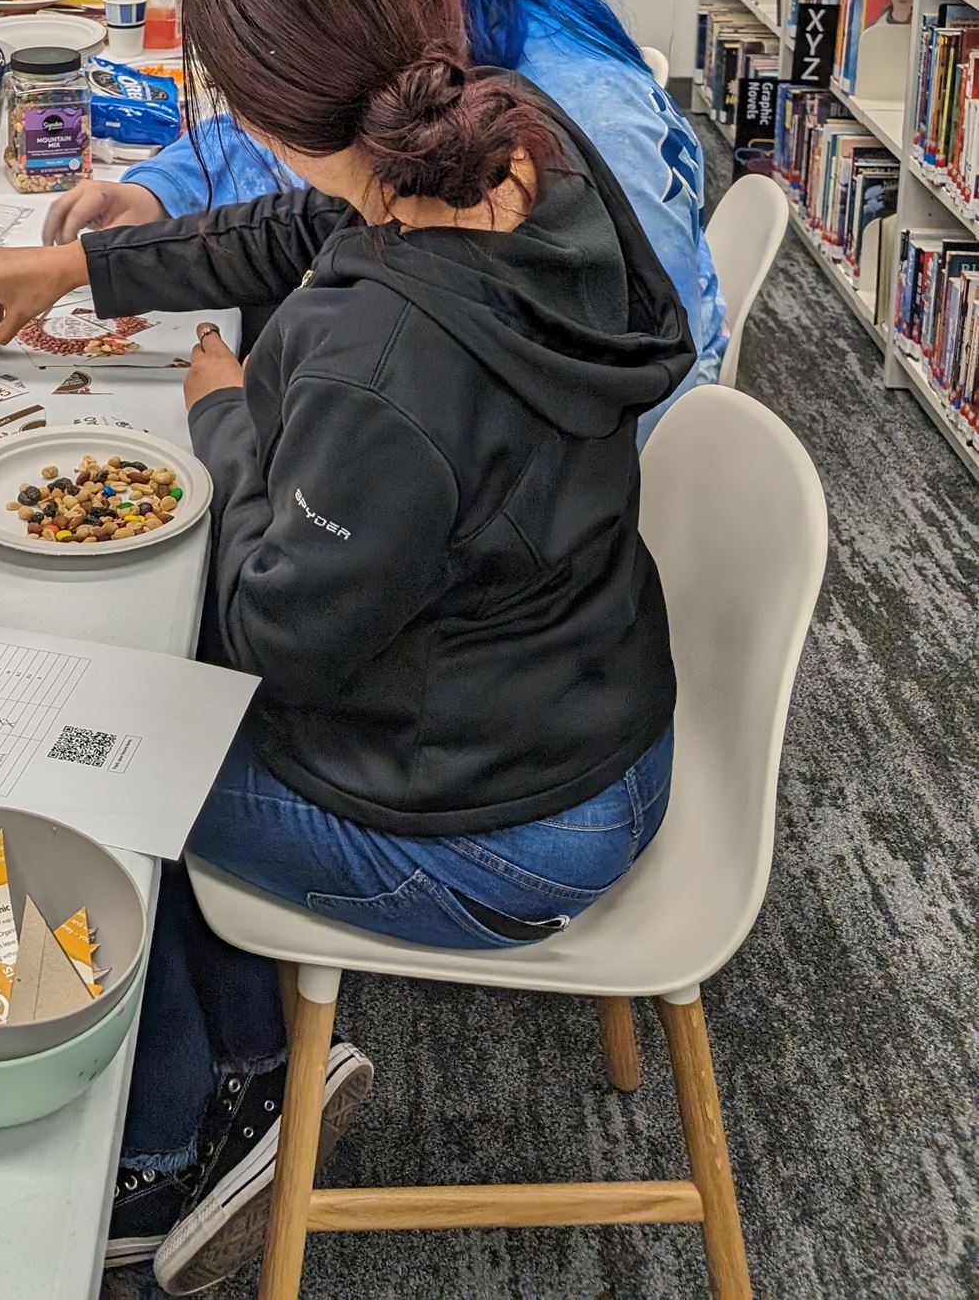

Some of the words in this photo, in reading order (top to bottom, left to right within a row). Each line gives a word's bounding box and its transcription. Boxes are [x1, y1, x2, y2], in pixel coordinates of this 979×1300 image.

[806, 8, 826, 32] X
[805, 33, 824, 56] Y
[801, 57, 820, 80] Z
[117, 75, 143, 100] ORE
[747, 82, 760, 120] Novels
[759, 82, 774, 126] Graphic
[295, 488, 351, 540] SPYDER
